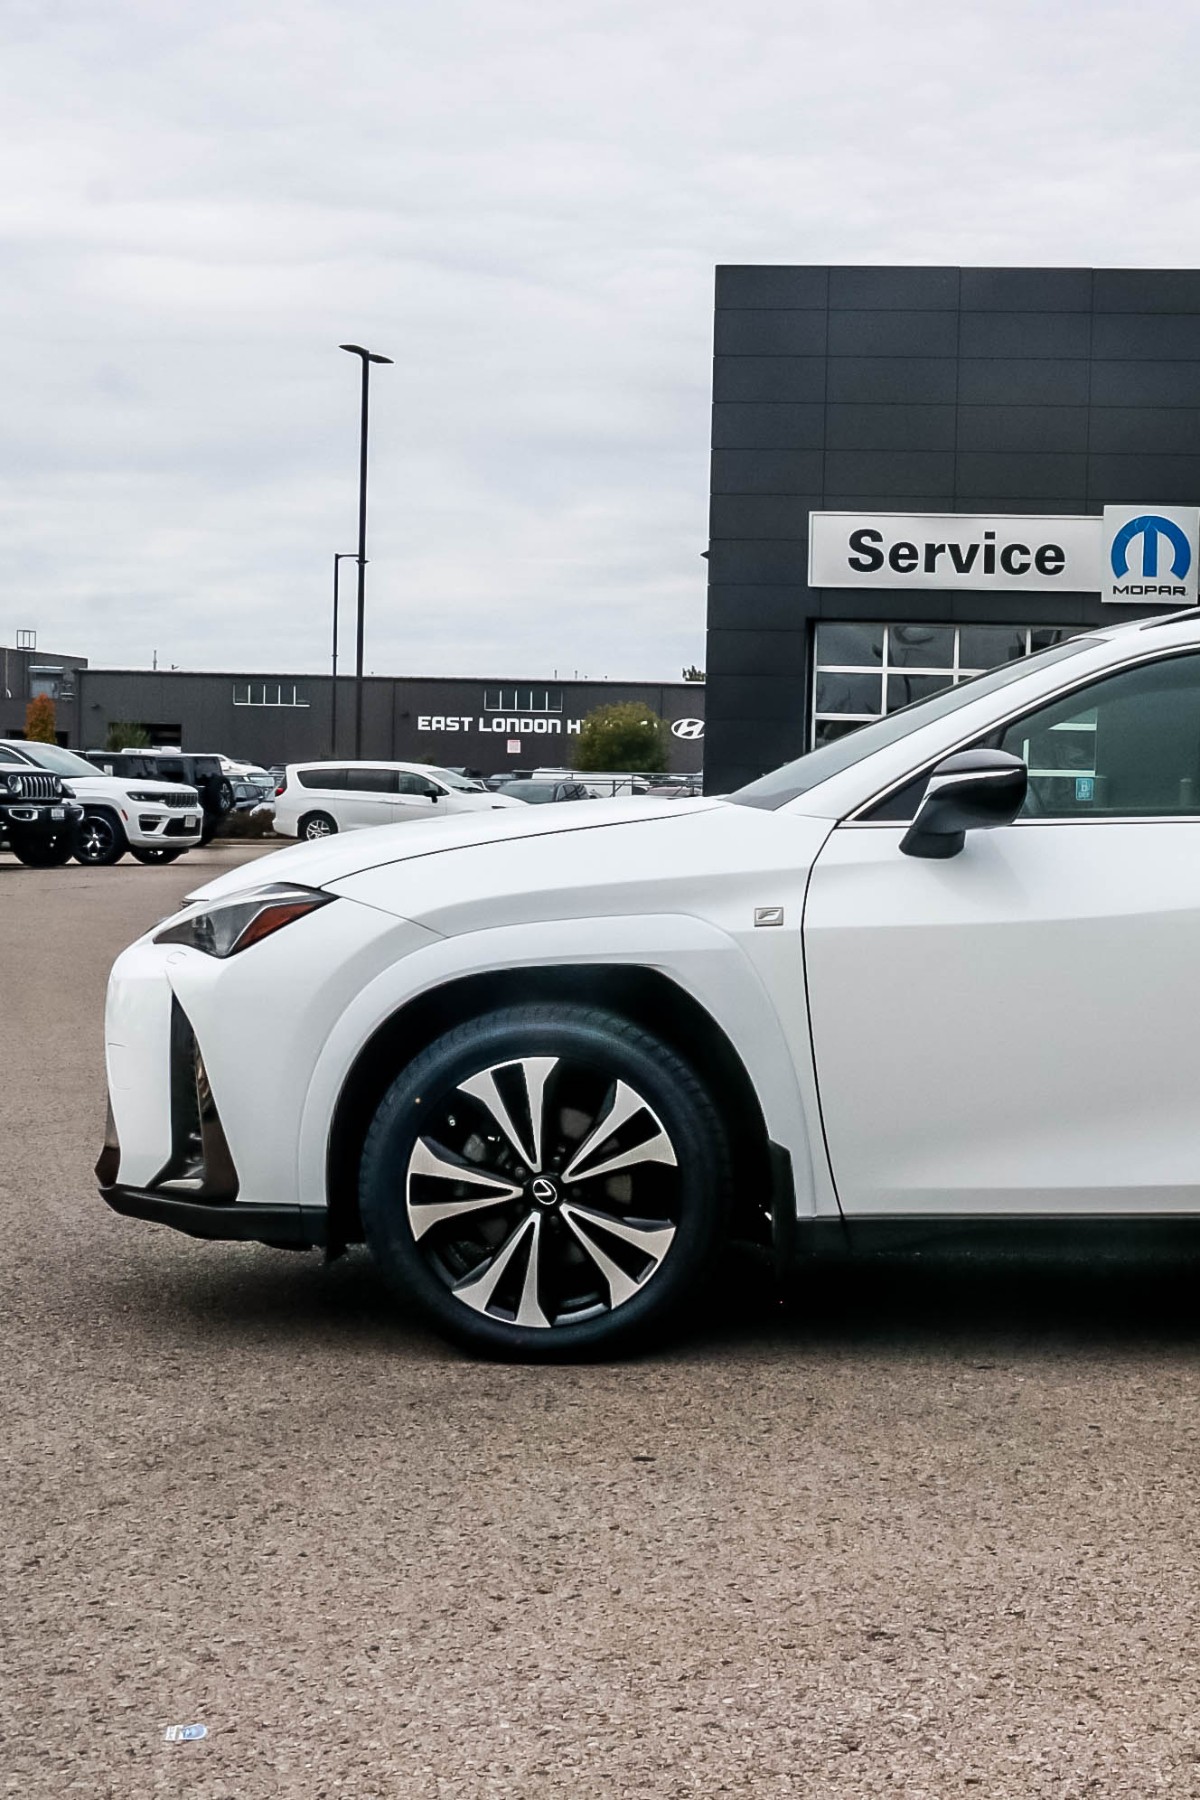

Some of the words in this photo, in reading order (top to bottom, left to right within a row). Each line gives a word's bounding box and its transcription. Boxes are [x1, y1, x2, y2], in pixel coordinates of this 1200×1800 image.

[847, 528, 1067, 576] Service
[1112, 585, 1187, 596] MOPAR
[417, 716, 474, 732] EAST
[478, 717, 562, 734] LONDON
